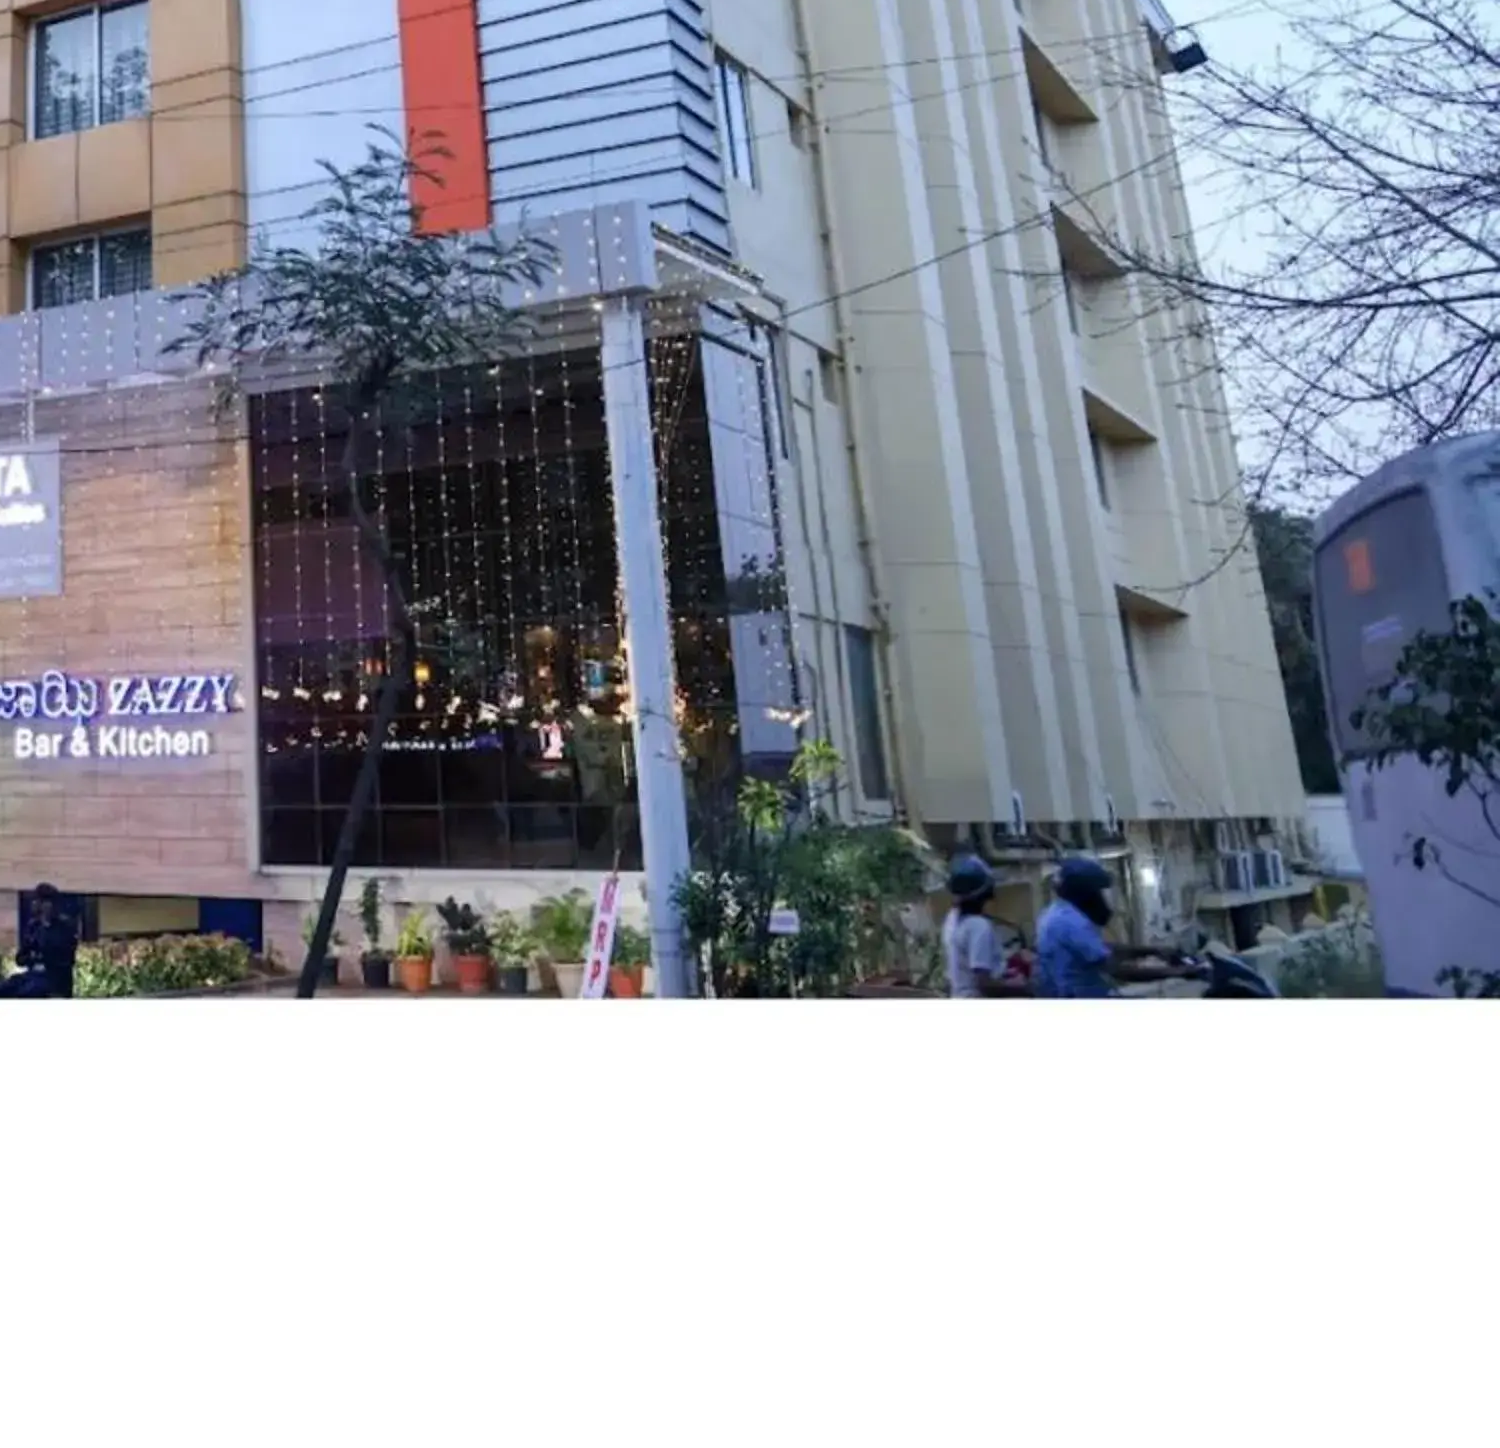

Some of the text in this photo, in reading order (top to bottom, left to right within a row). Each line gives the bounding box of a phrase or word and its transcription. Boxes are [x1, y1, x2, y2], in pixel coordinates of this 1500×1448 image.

[108, 673, 234, 716] ZAZZY
[14, 724, 210, 758] Bar & Kitchen
